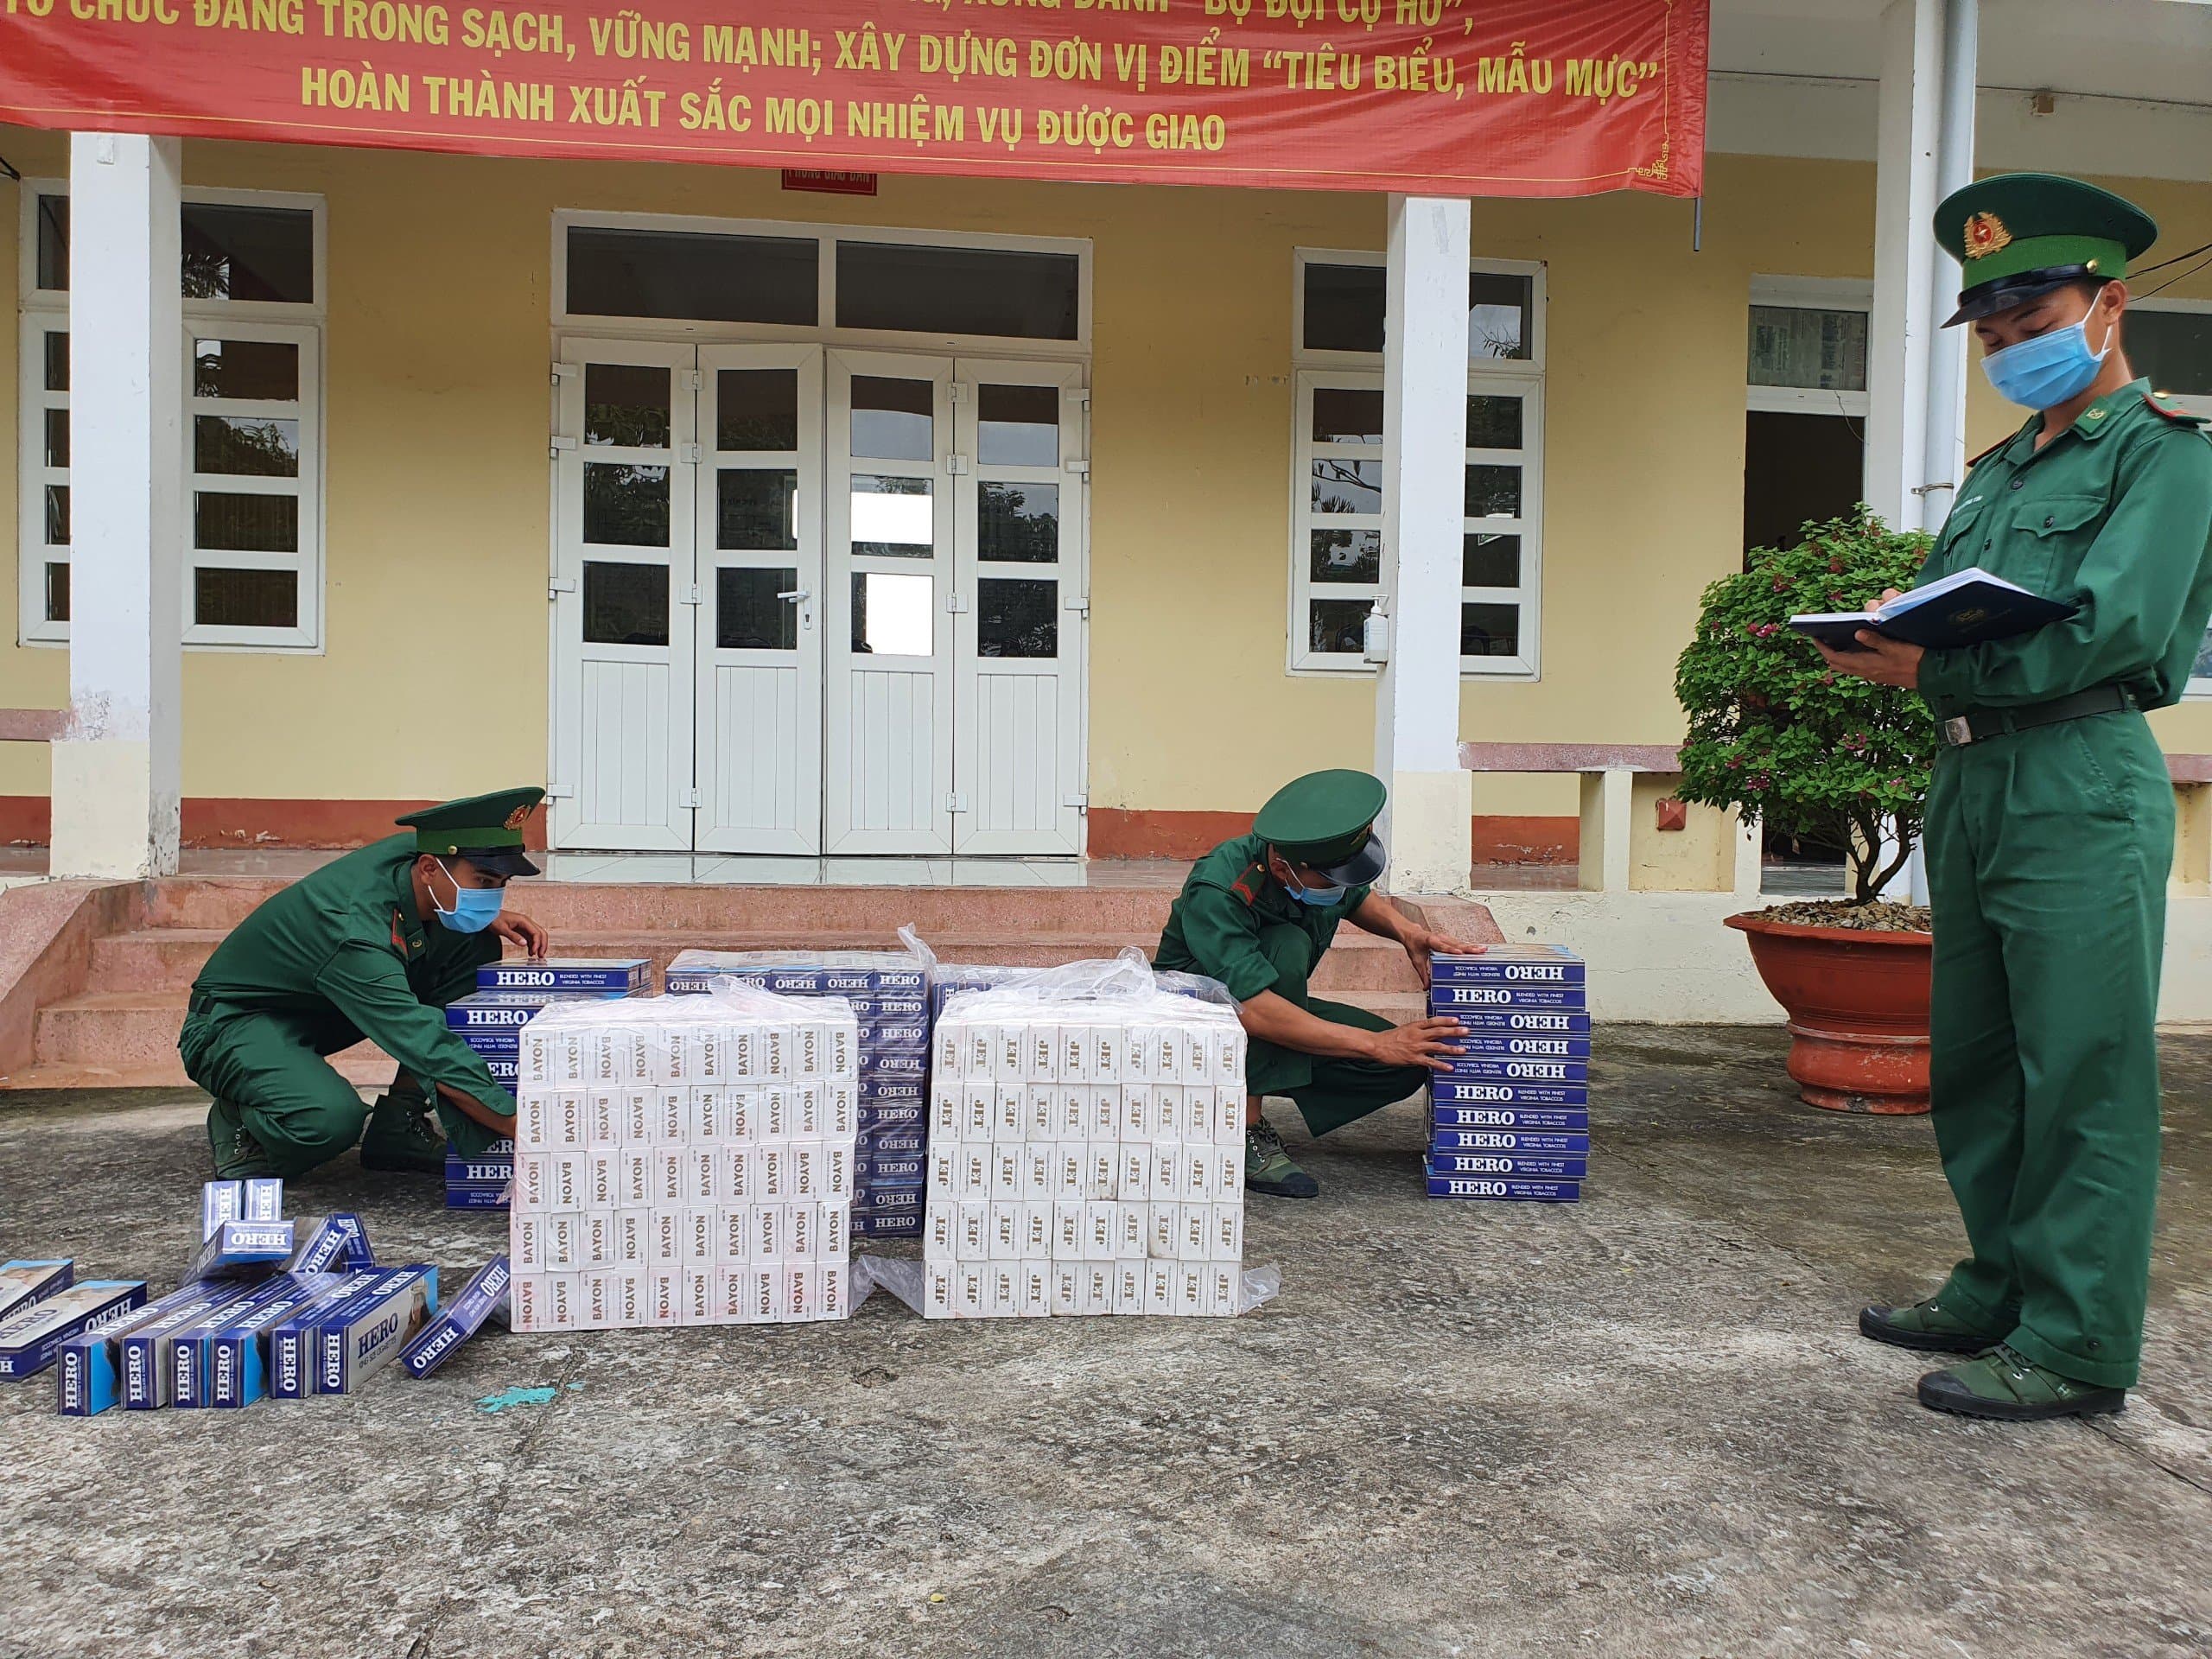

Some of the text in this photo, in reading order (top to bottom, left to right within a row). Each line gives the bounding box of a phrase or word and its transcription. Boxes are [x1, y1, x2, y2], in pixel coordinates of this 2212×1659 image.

[316, 0, 449, 46] TRONG
[461, 8, 576, 61] SẠCH,
[588, 10, 690, 62] VỮNG
[703, 24, 822, 75] MẠNH;
[835, 21, 906, 72] XÂY
[919, 29, 1017, 83] DỰNG
[1028, 35, 1102, 80] ĐƠN
[1114, 43, 1147, 92] VỊ
[1159, 26, 1249, 87] ĐIỂM
[1263, 41, 1361, 91] “TIÊU
[1374, 36, 1465, 99] BIỂU,
[1478, 40, 1553, 94] MẪU
[1565, 54, 1658, 105] MỰC”
[302, 60, 1225, 155] HOÀN THÀNH XUẤT SẮC MỌI NHIỆM VỤ ĐƯỢC GIAO
[497, 971, 555, 986] HERO
[776, 980, 817, 989] HERO
[828, 978, 868, 988] HERO
[880, 976, 919, 986] HERO
[1505, 966, 1564, 980] HERO
[881, 1002, 922, 1012] HERO
[1452, 988, 1511, 1003] HERO
[467, 1010, 529, 1025] HERO
[1510, 1014, 1569, 1030] HERO
[882, 1029, 922, 1038] HERO
[1510, 1039, 1568, 1054] HERO
[671, 1035, 680, 1077] BAYON
[704, 1034, 715, 1077] BAYON
[738, 1034, 748, 1076] BAYON
[769, 1033, 779, 1075] BAYON
[804, 1030, 814, 1072] BAYON
[835, 1032, 845, 1073] BAYON
[880, 1059, 919, 1069] HERO
[1068, 1041, 1080, 1069] JET
[1100, 1041, 1111, 1070] JET
[1161, 1041, 1173, 1069] JET
[1192, 1042, 1203, 1071] JET
[1222, 1043, 1234, 1071] JET
[486, 1062, 518, 1077] ER
[1507, 1063, 1566, 1078] HERO
[878, 1086, 918, 1096] HERO
[1454, 1085, 1512, 1101] HERO
[531, 1100, 540, 1143] BAYON
[632, 1096, 643, 1139] BAYON
[668, 1096, 677, 1138] BAYON
[702, 1094, 713, 1136] BAYON
[803, 1090, 813, 1133] BAYON
[836, 1090, 846, 1133] BAYON
[877, 1109, 918, 1119] HERO
[942, 1098, 953, 1128] JET
[1036, 1099, 1046, 1128] JET
[1068, 1099, 1079, 1127] JET
[1099, 1098, 1111, 1127] JET
[1193, 1100, 1205, 1128] JET
[1224, 1100, 1236, 1130] JET
[1457, 1109, 1515, 1125] HERO
[879, 1139, 919, 1149] HERO
[1459, 1133, 1516, 1147] HERO
[467, 1165, 512, 1179] HER
[700, 1154, 710, 1197] BAYON
[734, 1154, 744, 1196] BAYON
[767, 1153, 778, 1195] BAYON
[877, 1163, 918, 1173] HERO
[938, 1158, 949, 1186] JET
[970, 1157, 982, 1186] JET
[1001, 1156, 1013, 1185] JET
[1097, 1157, 1109, 1186] JET
[1128, 1156, 1141, 1185] JET
[1160, 1157, 1171, 1186] JET
[1454, 1157, 1512, 1172] HERO
[528, 1161, 538, 1204] BAYON
[562, 1161, 572, 1205] BAYON
[597, 1160, 607, 1202] BAYON
[1449, 1180, 1507, 1195] HERO
[876, 1195, 916, 1204] HERO
[763, 1212, 772, 1254] BAYON
[795, 1211, 806, 1253] BAYON
[829, 1211, 838, 1252] BAYON
[875, 1217, 915, 1227] HERO
[999, 1215, 1010, 1244] JET
[1031, 1216, 1042, 1245] JET
[1063, 1216, 1074, 1245] JET
[1158, 1216, 1169, 1244] JET
[1189, 1217, 1200, 1246] JET
[1221, 1218, 1232, 1246] JET
[231, 1232, 287, 1246] HERO
[592, 1219, 602, 1262] BAYON
[626, 1218, 635, 1260] BAYON
[661, 1216, 671, 1258] BAYON
[305, 1230, 342, 1274] HERO
[331, 1274, 380, 1298] HERO
[372, 1271, 419, 1295] HERO
[480, 1265, 510, 1297] HERO
[694, 1274, 704, 1317] BAYON
[728, 1274, 738, 1315] BAYON
[826, 1270, 836, 1313] BAYON
[935, 1274, 946, 1304] JET
[967, 1274, 978, 1304] JET
[1060, 1273, 1071, 1302] JET
[1092, 1272, 1103, 1301] JET
[1123, 1271, 1135, 1300] JET
[1217, 1271, 1229, 1301] JET
[522, 1281, 532, 1324] BAYON
[556, 1281, 566, 1323] BAYON
[659, 1276, 669, 1319] BAYON
[86, 1298, 132, 1332] HERO
[89, 1306, 159, 1336] HERO
[149, 1302, 212, 1329] HERO
[194, 1300, 255, 1329] HERO
[235, 1300, 294, 1329] HERO
[358, 1313, 398, 1359] HERO
[413, 1326, 459, 1369] HERO
[128, 1345, 143, 1402] HERO
[177, 1344, 190, 1401] HERO
[218, 1344, 231, 1401] HERO
[283, 1337, 296, 1392] HERO
[327, 1333, 340, 1388] HERO
[65, 1351, 78, 1409] HERO
